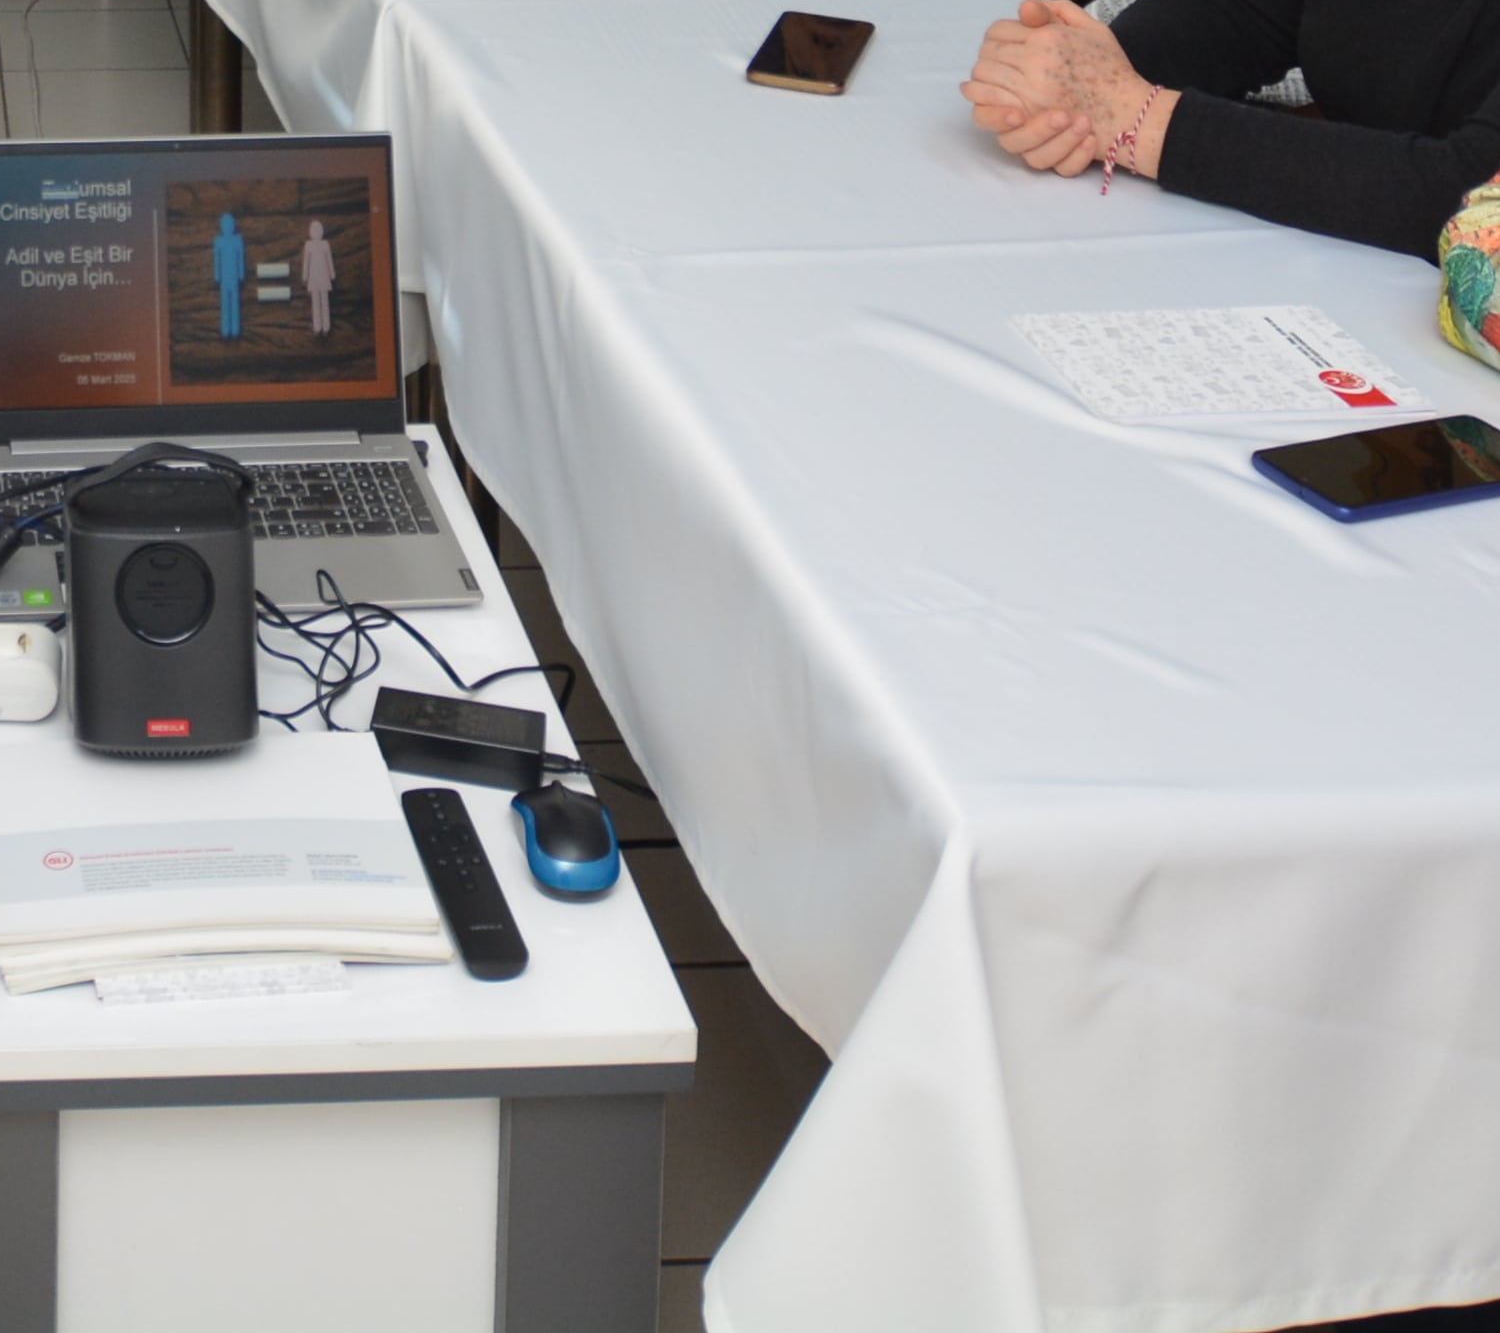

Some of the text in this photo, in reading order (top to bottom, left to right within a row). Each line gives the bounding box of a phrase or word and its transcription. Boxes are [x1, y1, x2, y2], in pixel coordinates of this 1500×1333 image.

[0, 201, 132, 224] Cinsiyet Eşitliği
[5, 245, 134, 267] Adil ve Eşit Bir
[20, 269, 78, 291] Dünya
